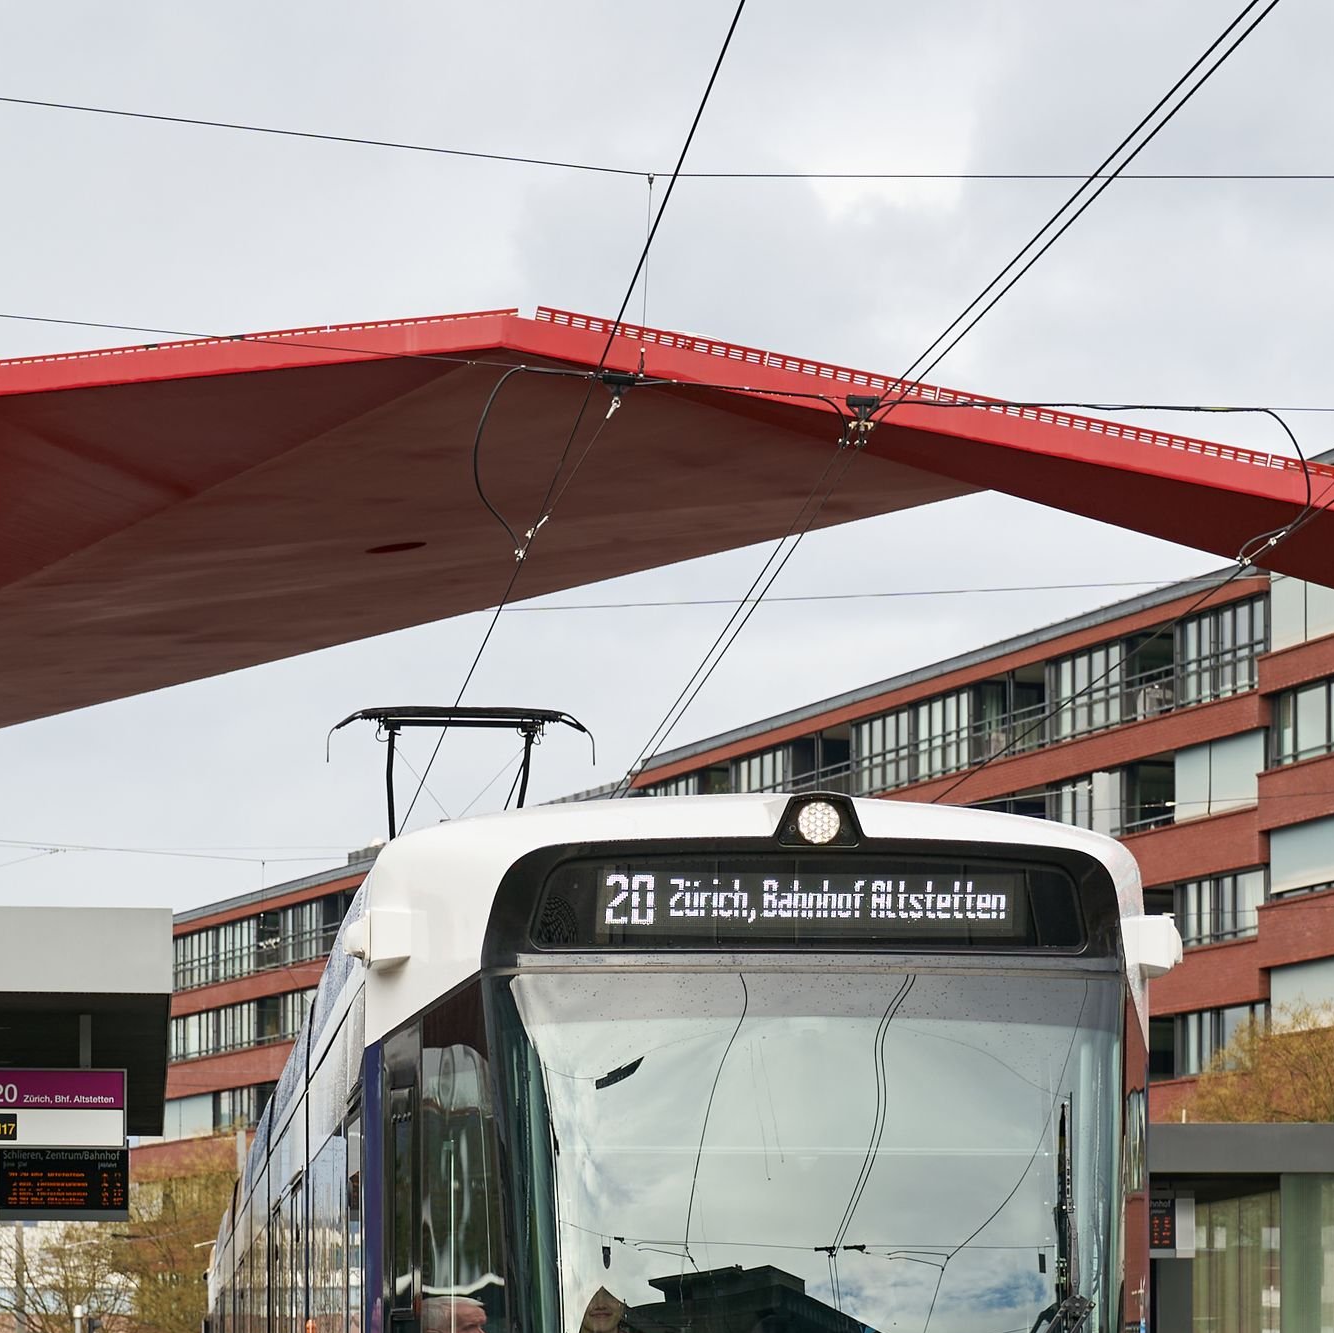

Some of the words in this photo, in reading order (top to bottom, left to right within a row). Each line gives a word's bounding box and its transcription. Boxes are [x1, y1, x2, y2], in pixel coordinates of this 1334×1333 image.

[605, 874, 655, 925] 20
[669, 878, 758, 923] Zürich,
[762, 878, 866, 919] Bahnhof
[870, 879, 1007, 920] Altstetten
[23, 1094, 53, 1104] Zürich,
[54, 1094, 72, 1103] Bhf.
[73, 1095, 115, 1104] Altstetten
[2, 1150, 44, 1161] Schlieren,
[45, 1150, 121, 1161] Zentrum/Bahnhof
